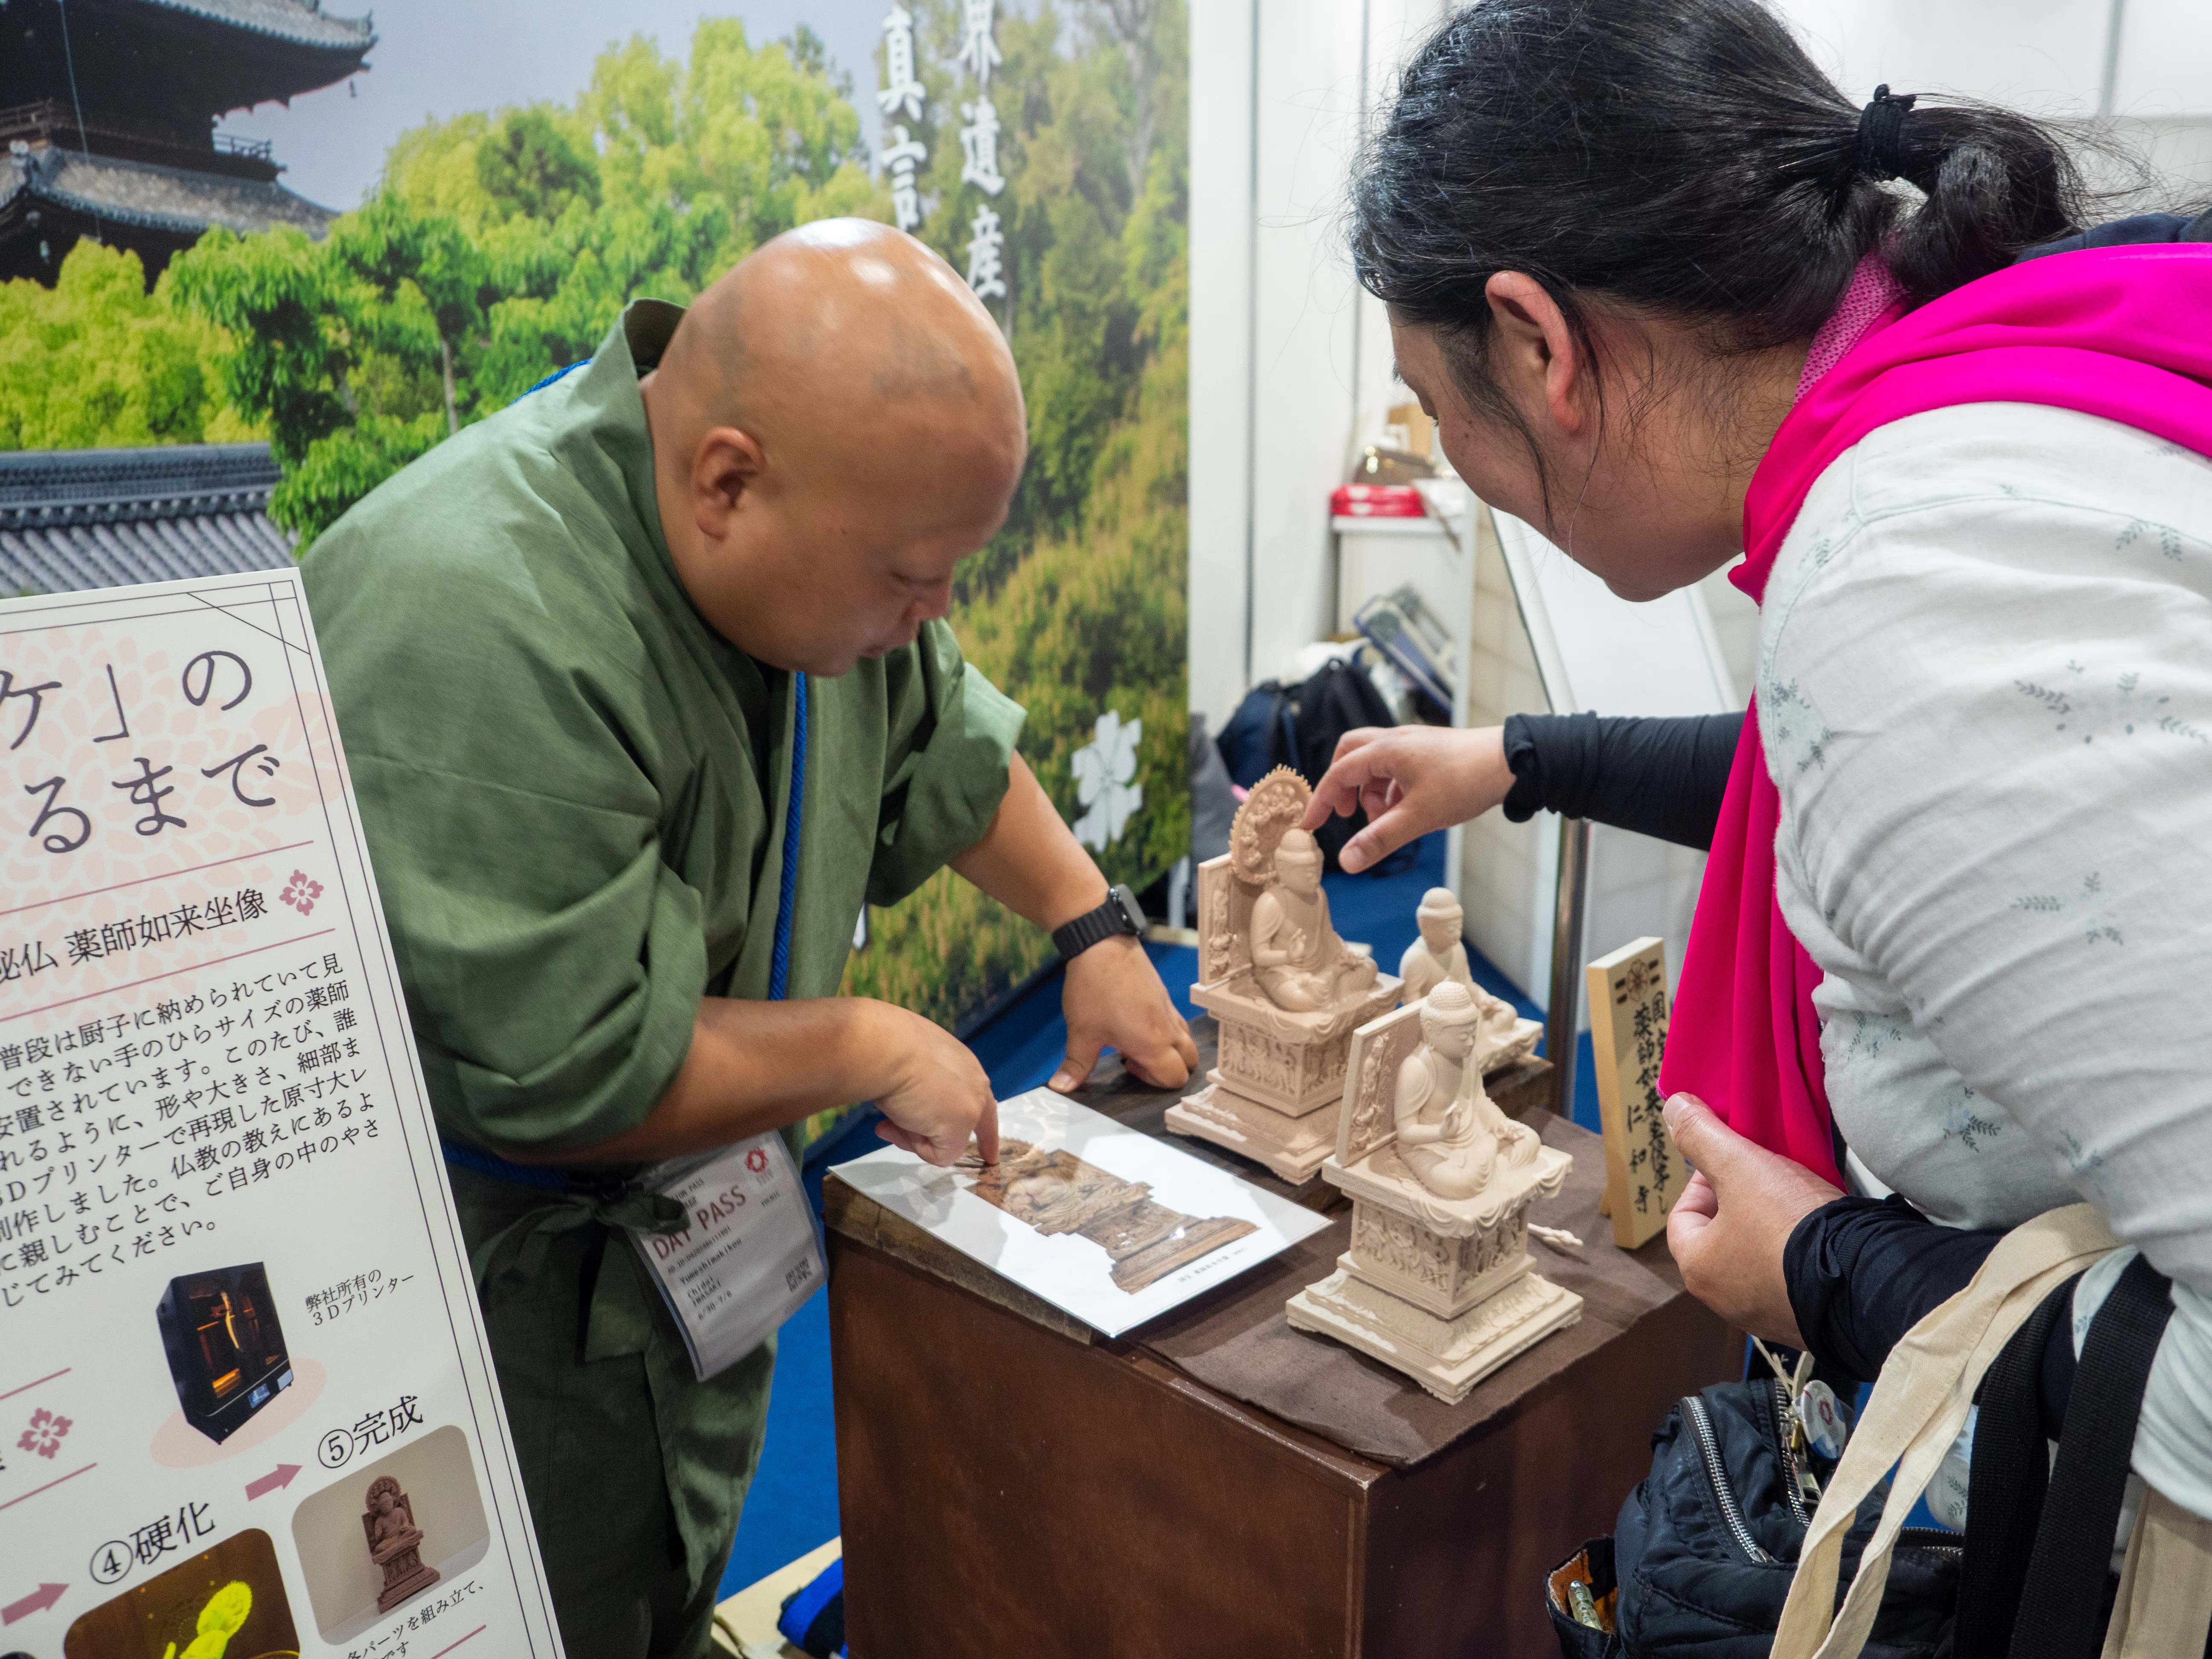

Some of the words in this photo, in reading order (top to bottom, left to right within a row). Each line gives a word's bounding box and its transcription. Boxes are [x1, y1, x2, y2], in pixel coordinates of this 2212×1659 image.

[24, 744, 279, 853] るまで
[64, 888, 268, 966] 薬師如来坐像
[7, 980, 349, 1097] できない手のひらサイズの薬師
[0, 1066, 367, 1207] Dプリンターで再現した原寸大レ
[1627, 1104, 1650, 1214] 仁和寺
[696, 1185, 745, 1231] PASS
[2, 1215, 215, 1307] じてみてください。
[306, 1269, 381, 1313] 弊社所有の
